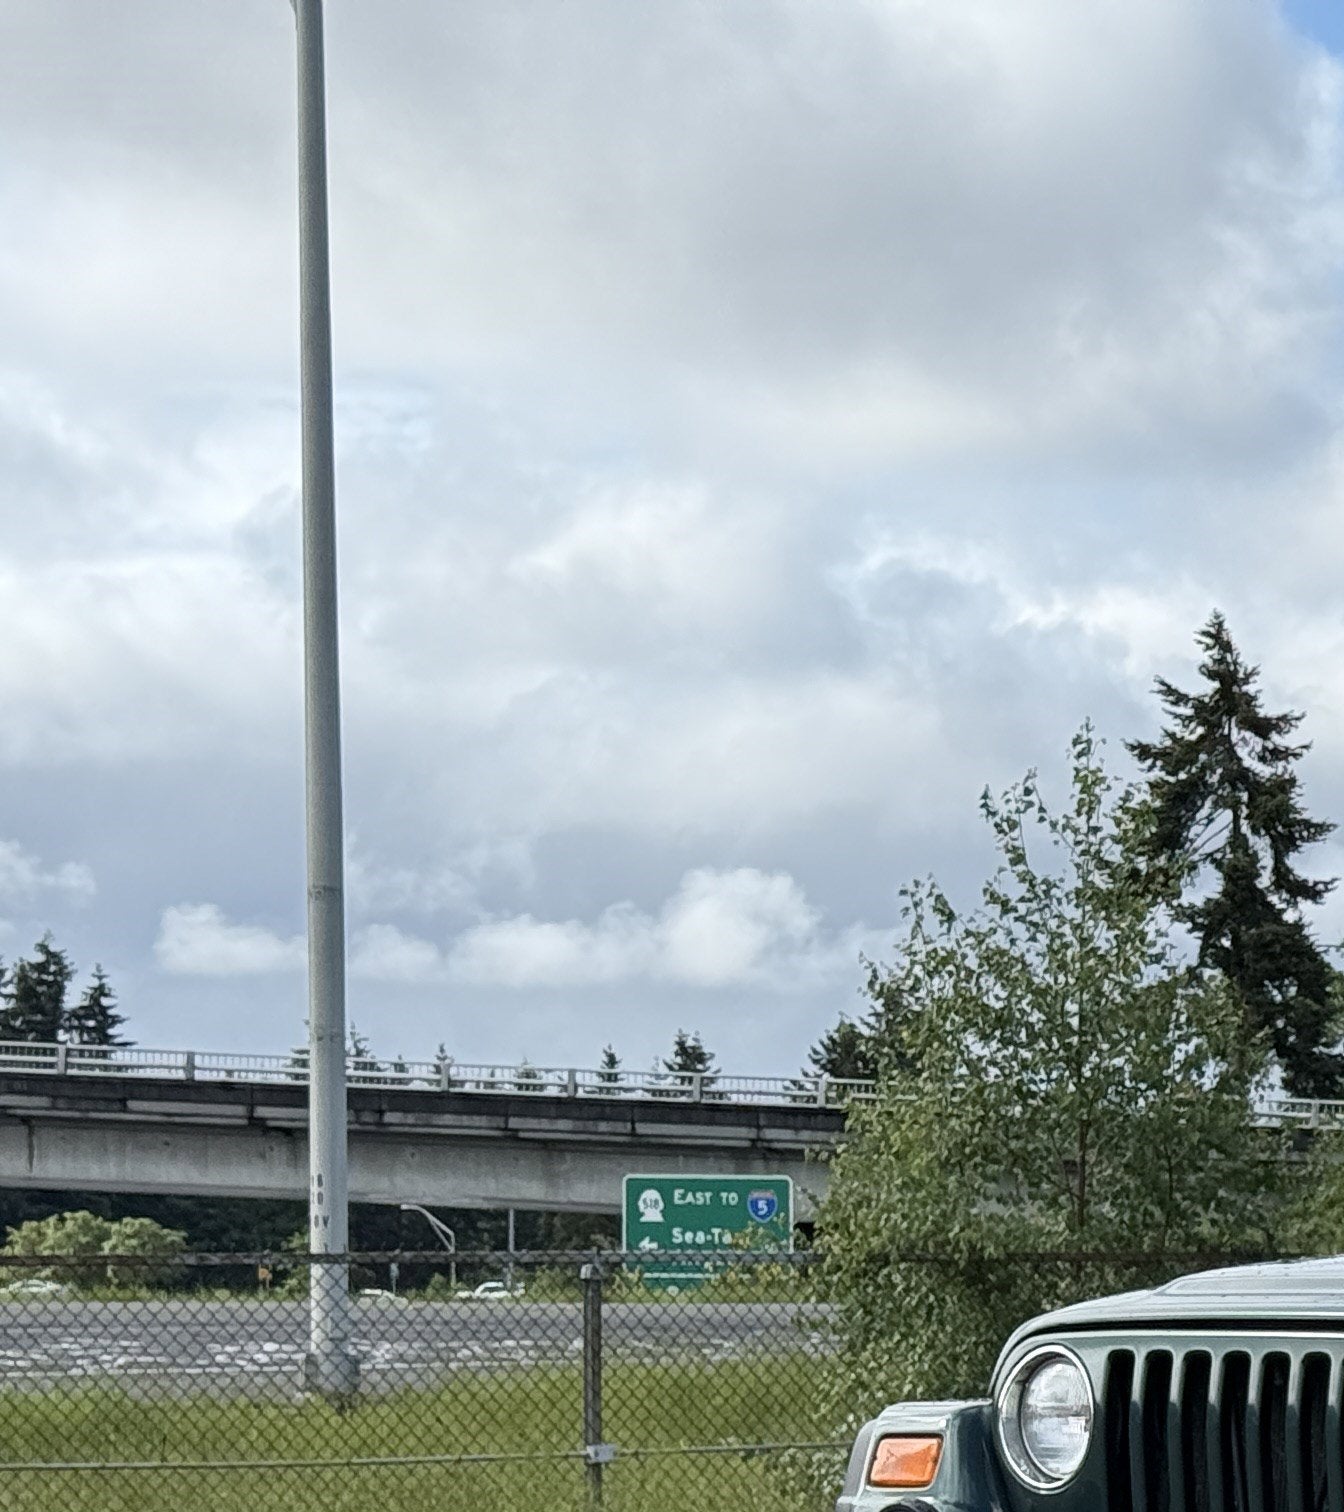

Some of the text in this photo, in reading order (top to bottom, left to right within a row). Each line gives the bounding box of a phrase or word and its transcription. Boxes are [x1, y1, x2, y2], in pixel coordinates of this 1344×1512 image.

[643, 1197, 660, 1210] 518
[673, 1188, 713, 1206] EAST
[757, 1199, 768, 1216] 5
